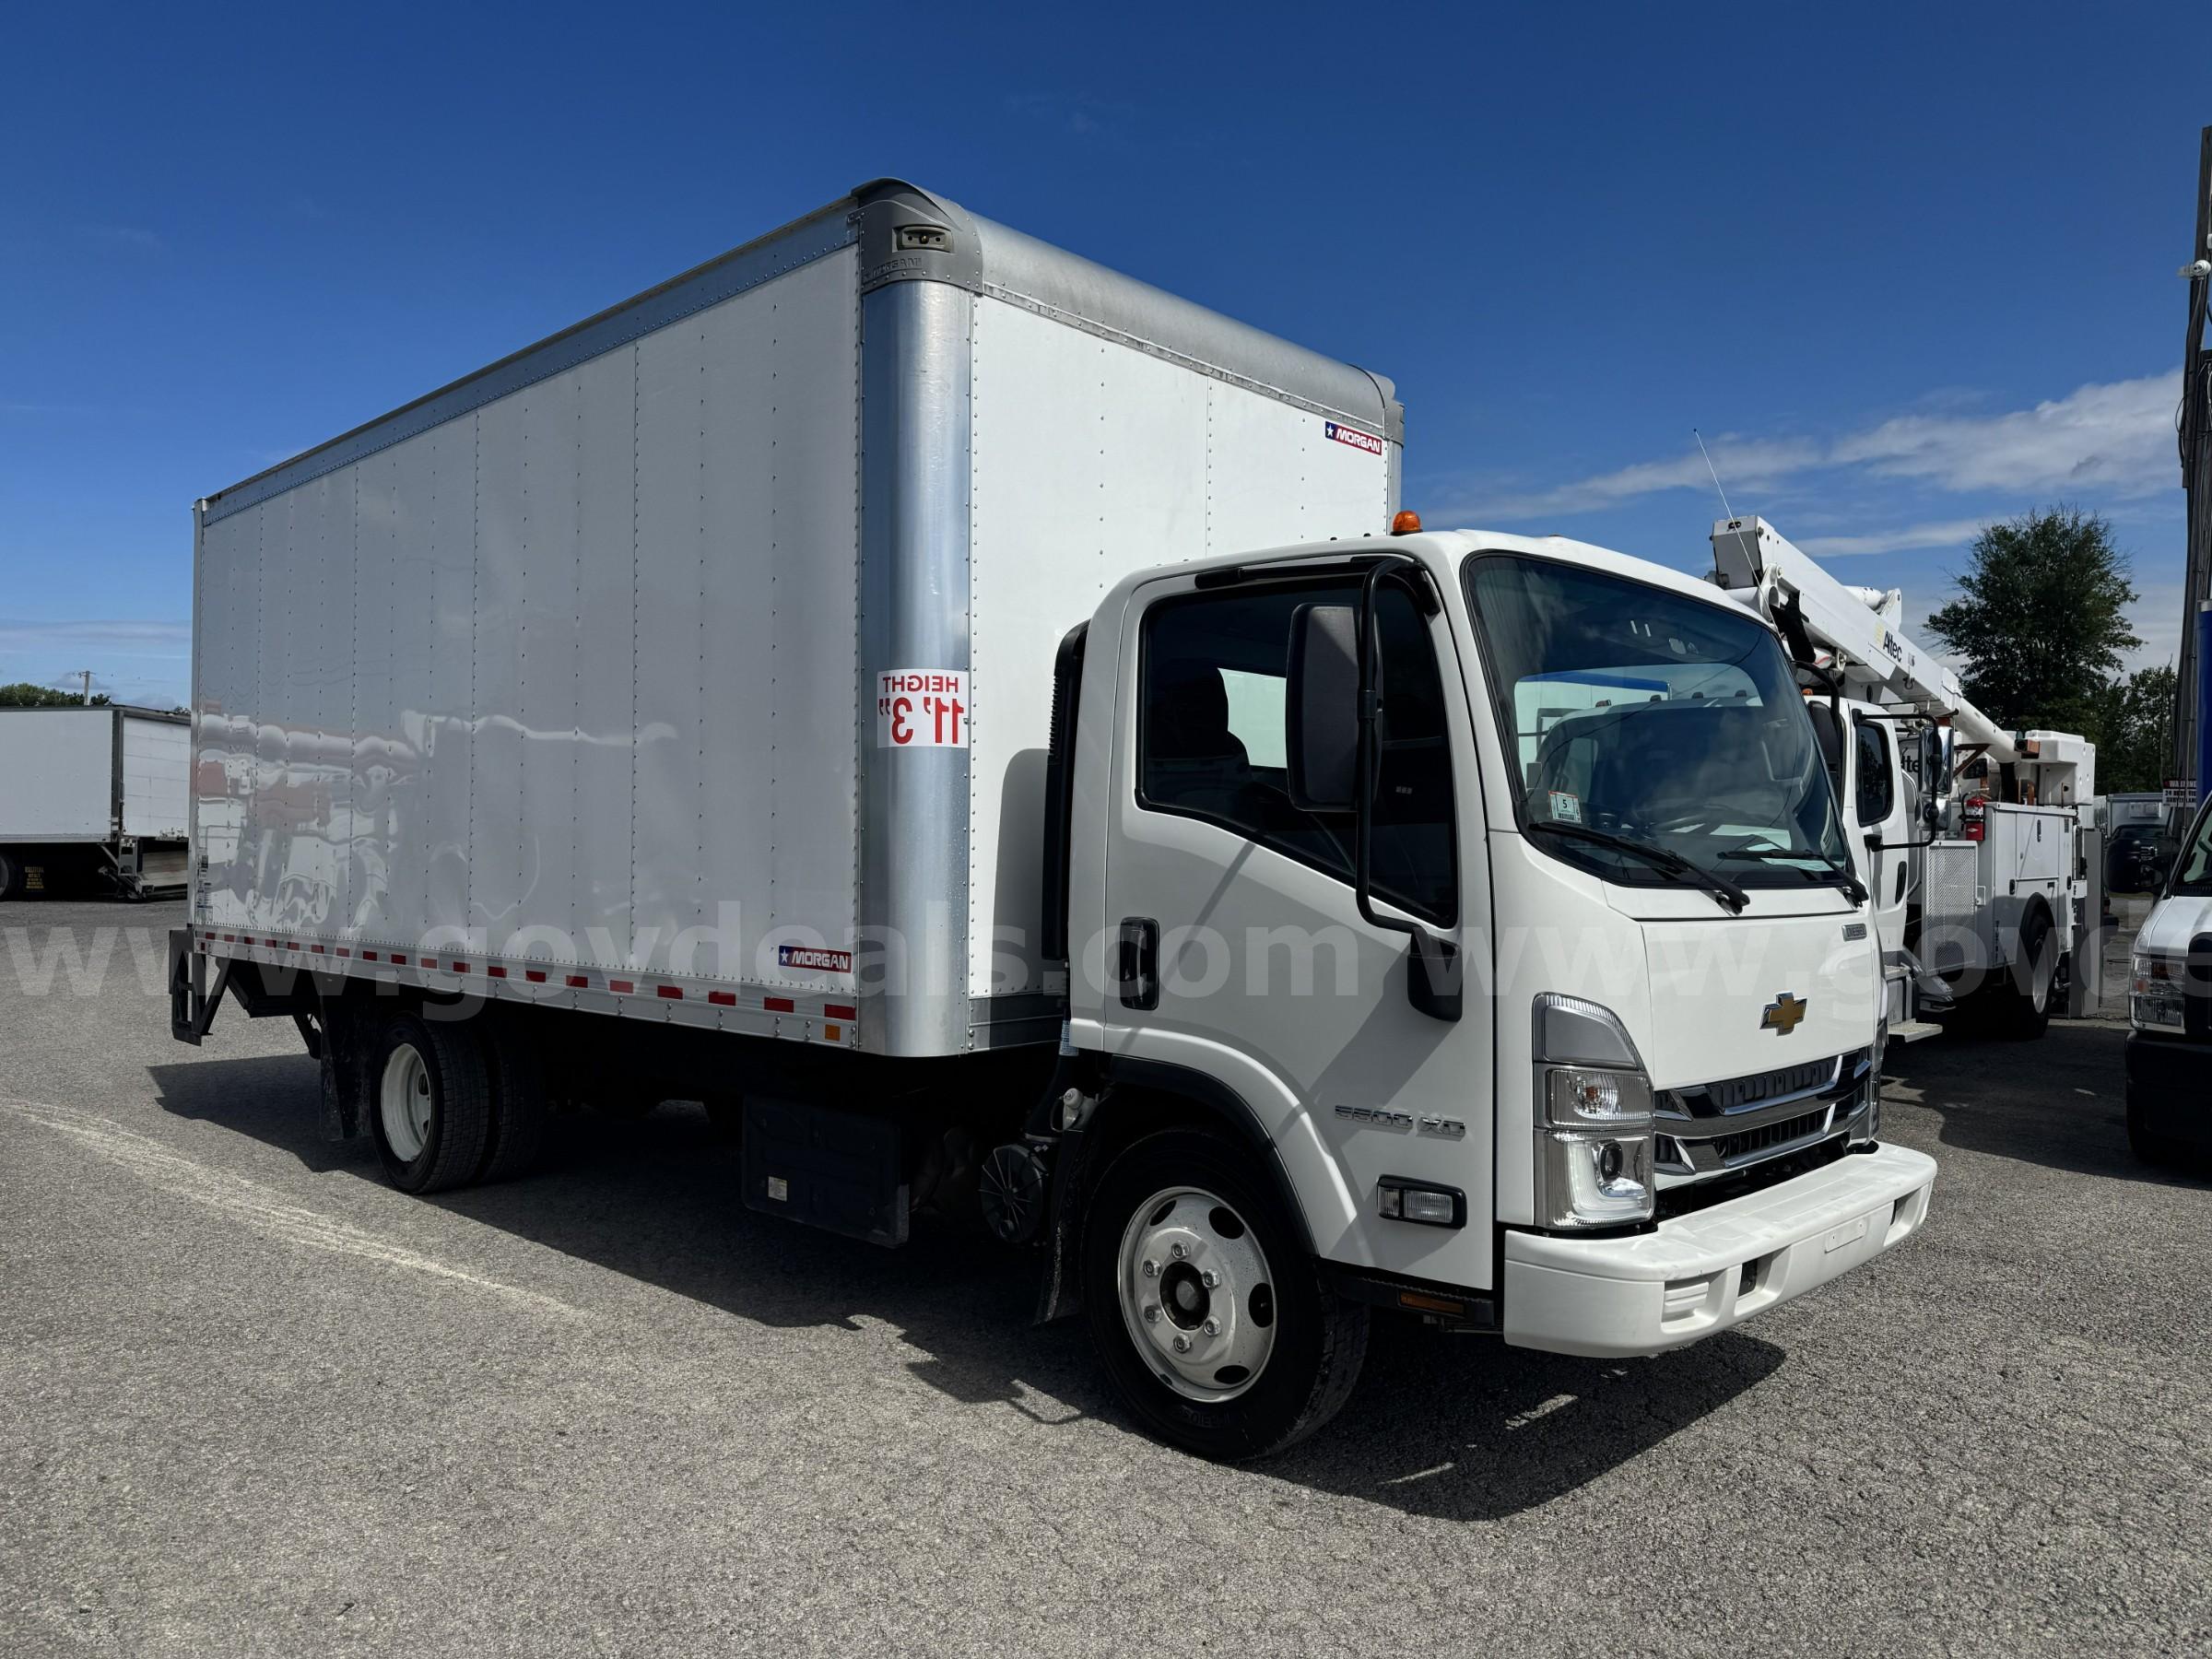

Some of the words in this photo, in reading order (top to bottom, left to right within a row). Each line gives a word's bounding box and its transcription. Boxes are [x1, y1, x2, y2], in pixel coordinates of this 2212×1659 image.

[1336, 428, 1381, 453] MORGAN
[1883, 629, 1902, 663] Altec
[1562, 799, 1568, 809] 5
[792, 950, 849, 970] MORGAN
[1335, 1105, 1413, 1130] 5500
[1419, 1115, 1465, 1136] XD
